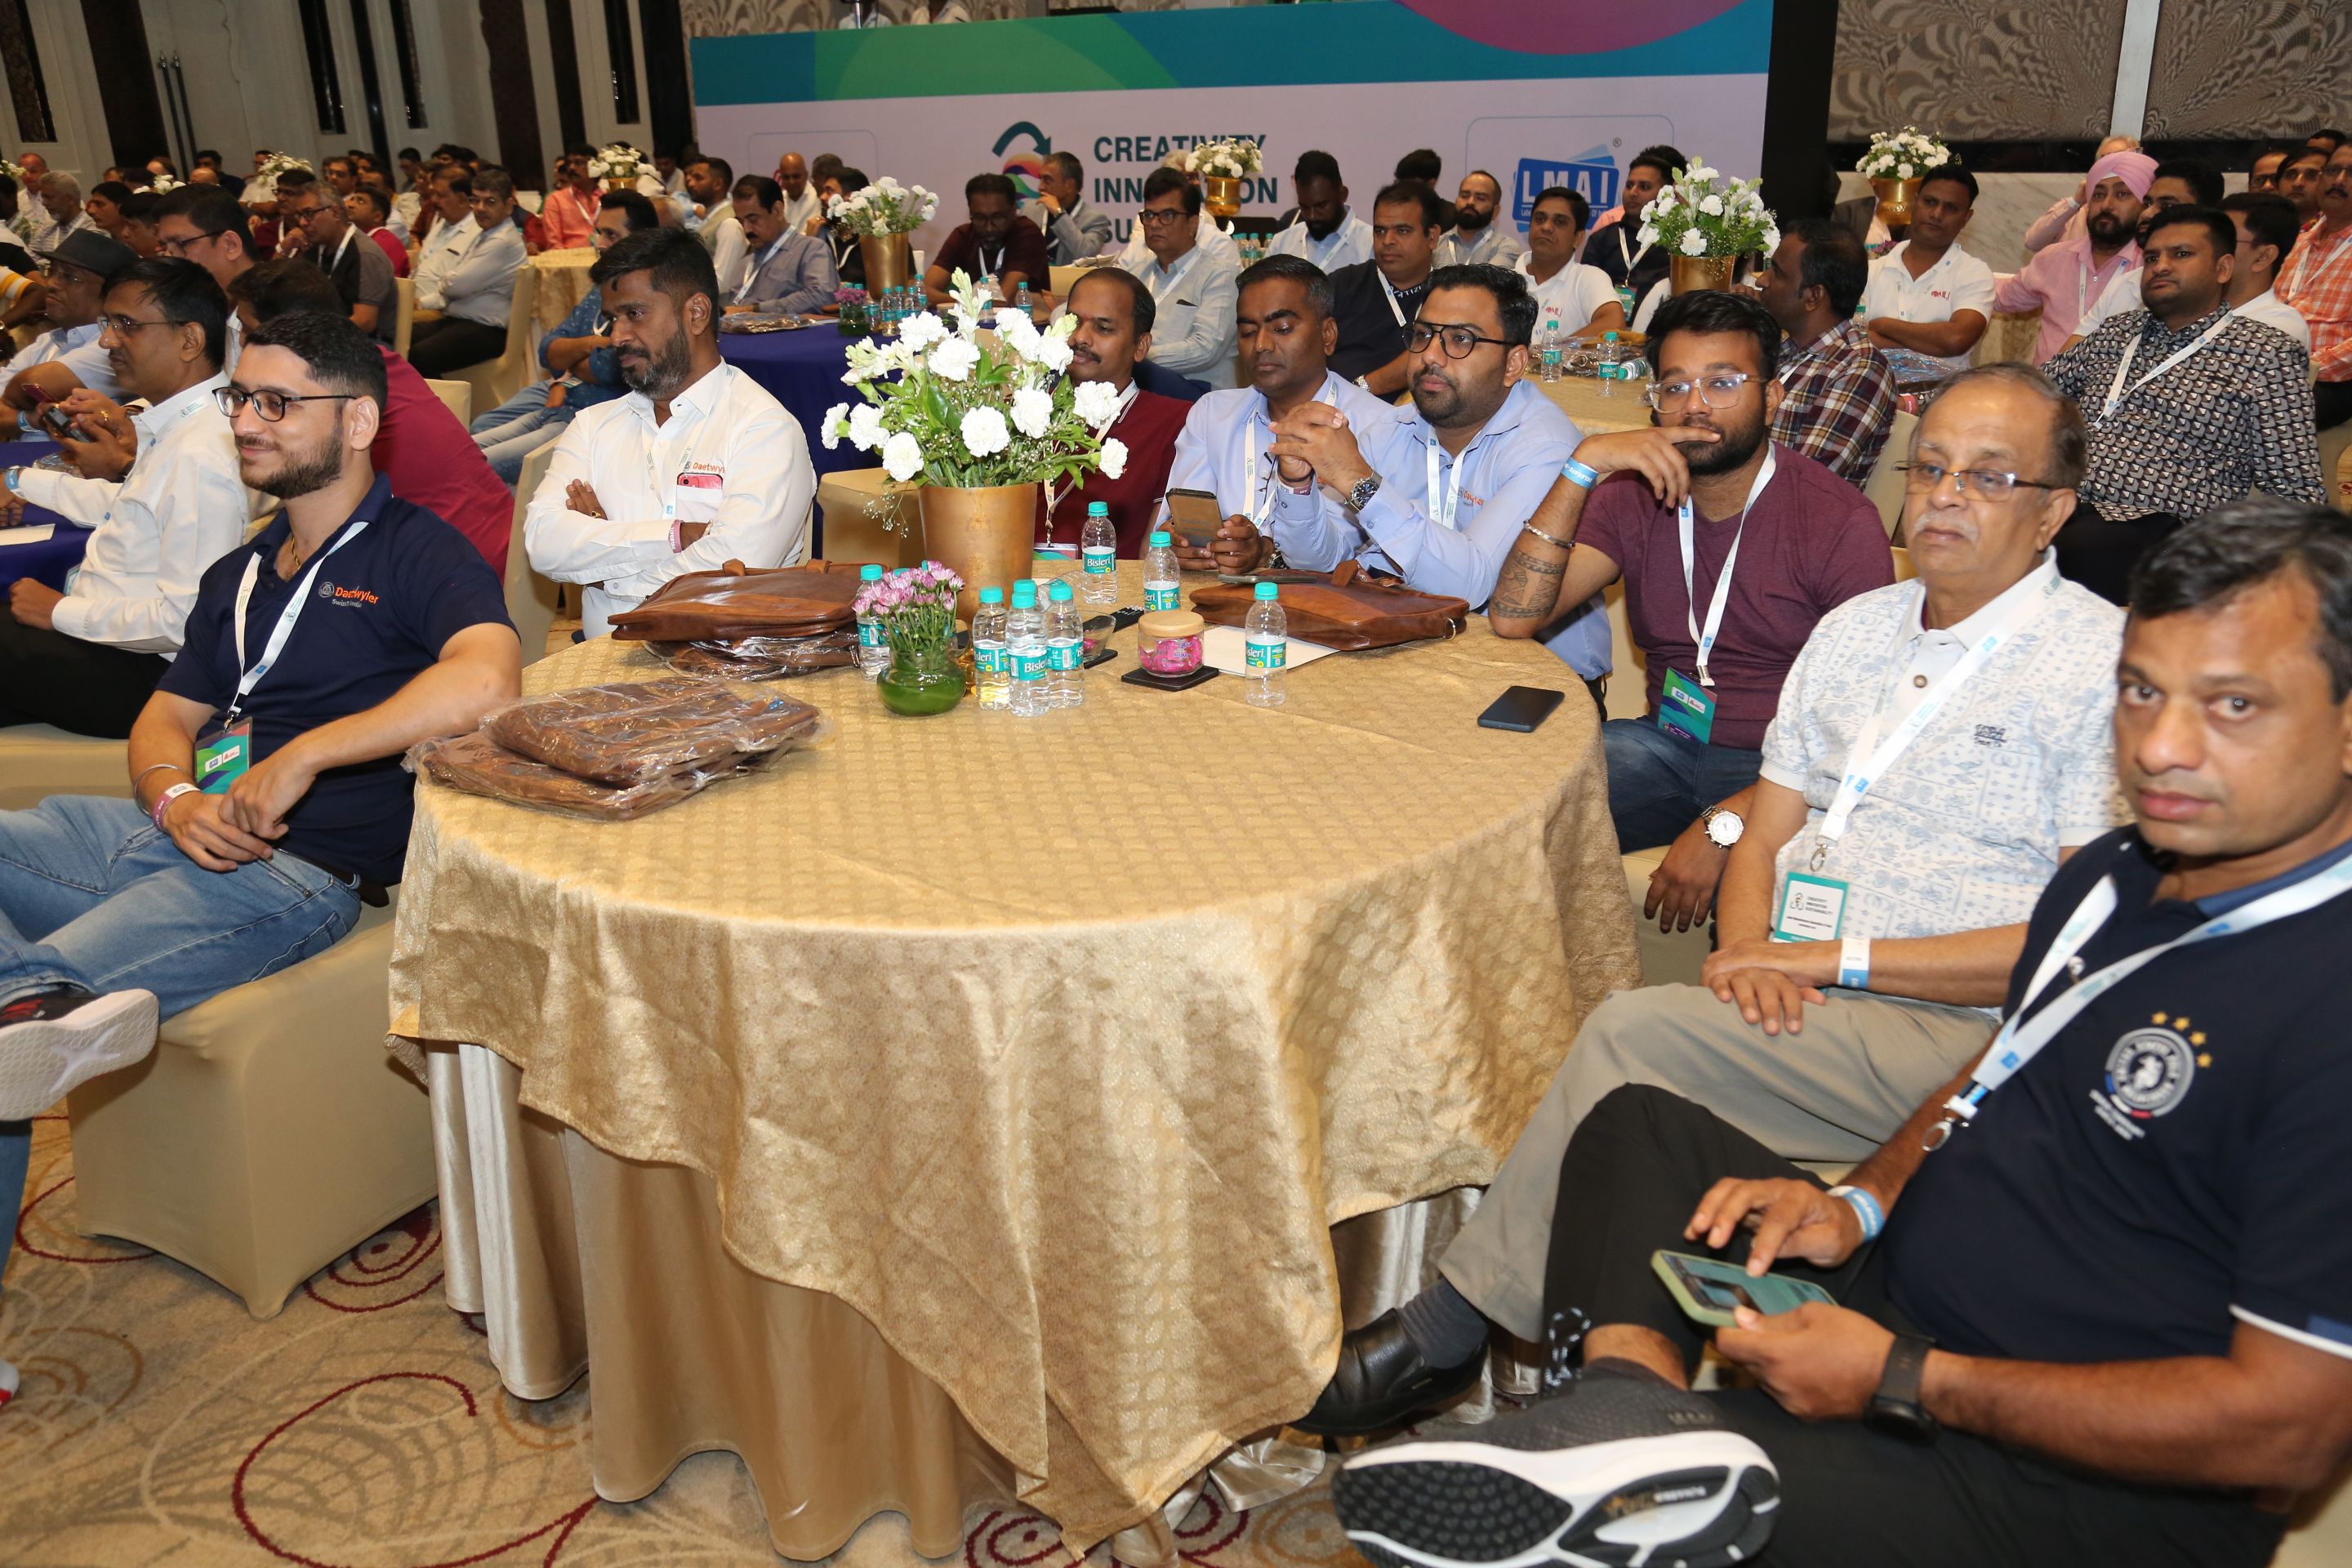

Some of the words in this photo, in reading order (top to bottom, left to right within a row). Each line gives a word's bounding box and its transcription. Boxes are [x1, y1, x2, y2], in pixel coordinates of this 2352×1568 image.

[1094, 176, 1277, 203] INNON
[1522, 170, 1610, 203] LMAI
[1087, 556, 1111, 567] Bisleri
[1247, 646, 1265, 659] sleri
